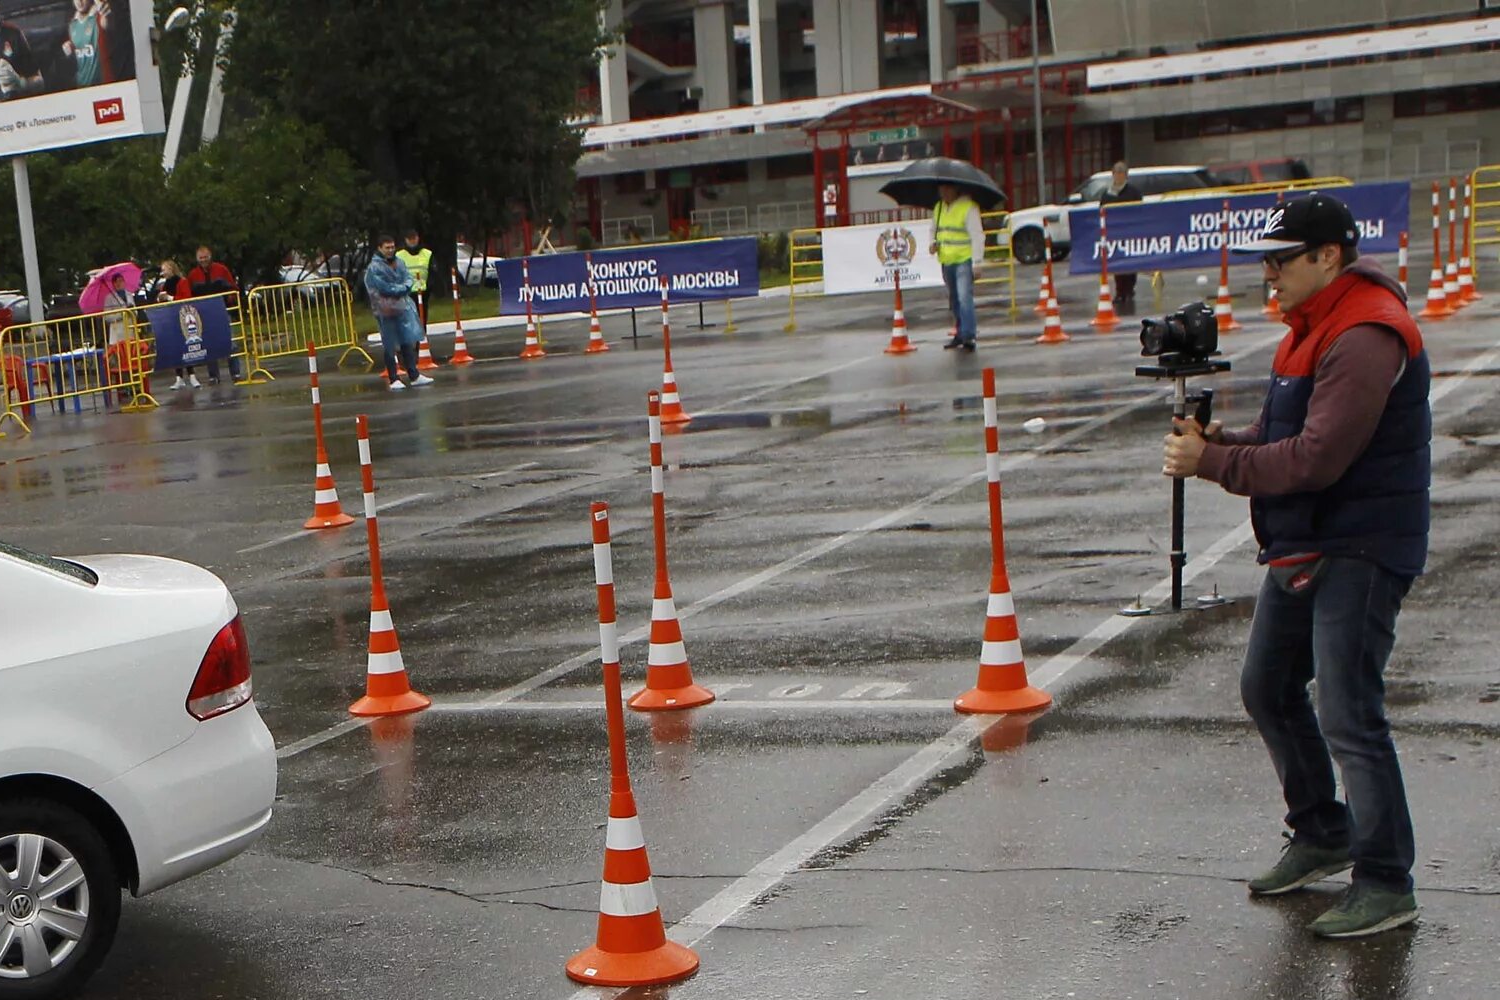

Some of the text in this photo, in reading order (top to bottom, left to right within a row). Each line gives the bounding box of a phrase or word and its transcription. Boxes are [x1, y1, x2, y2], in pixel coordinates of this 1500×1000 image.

[16, 119, 27, 129] ФК
[1093, 234, 1171, 260] ЛУЧШАЯ
[590, 259, 657, 280] КОНКУРС
[518, 283, 577, 302] ЛУЧШАЯ
[672, 269, 739, 290] МОСКВЫ
